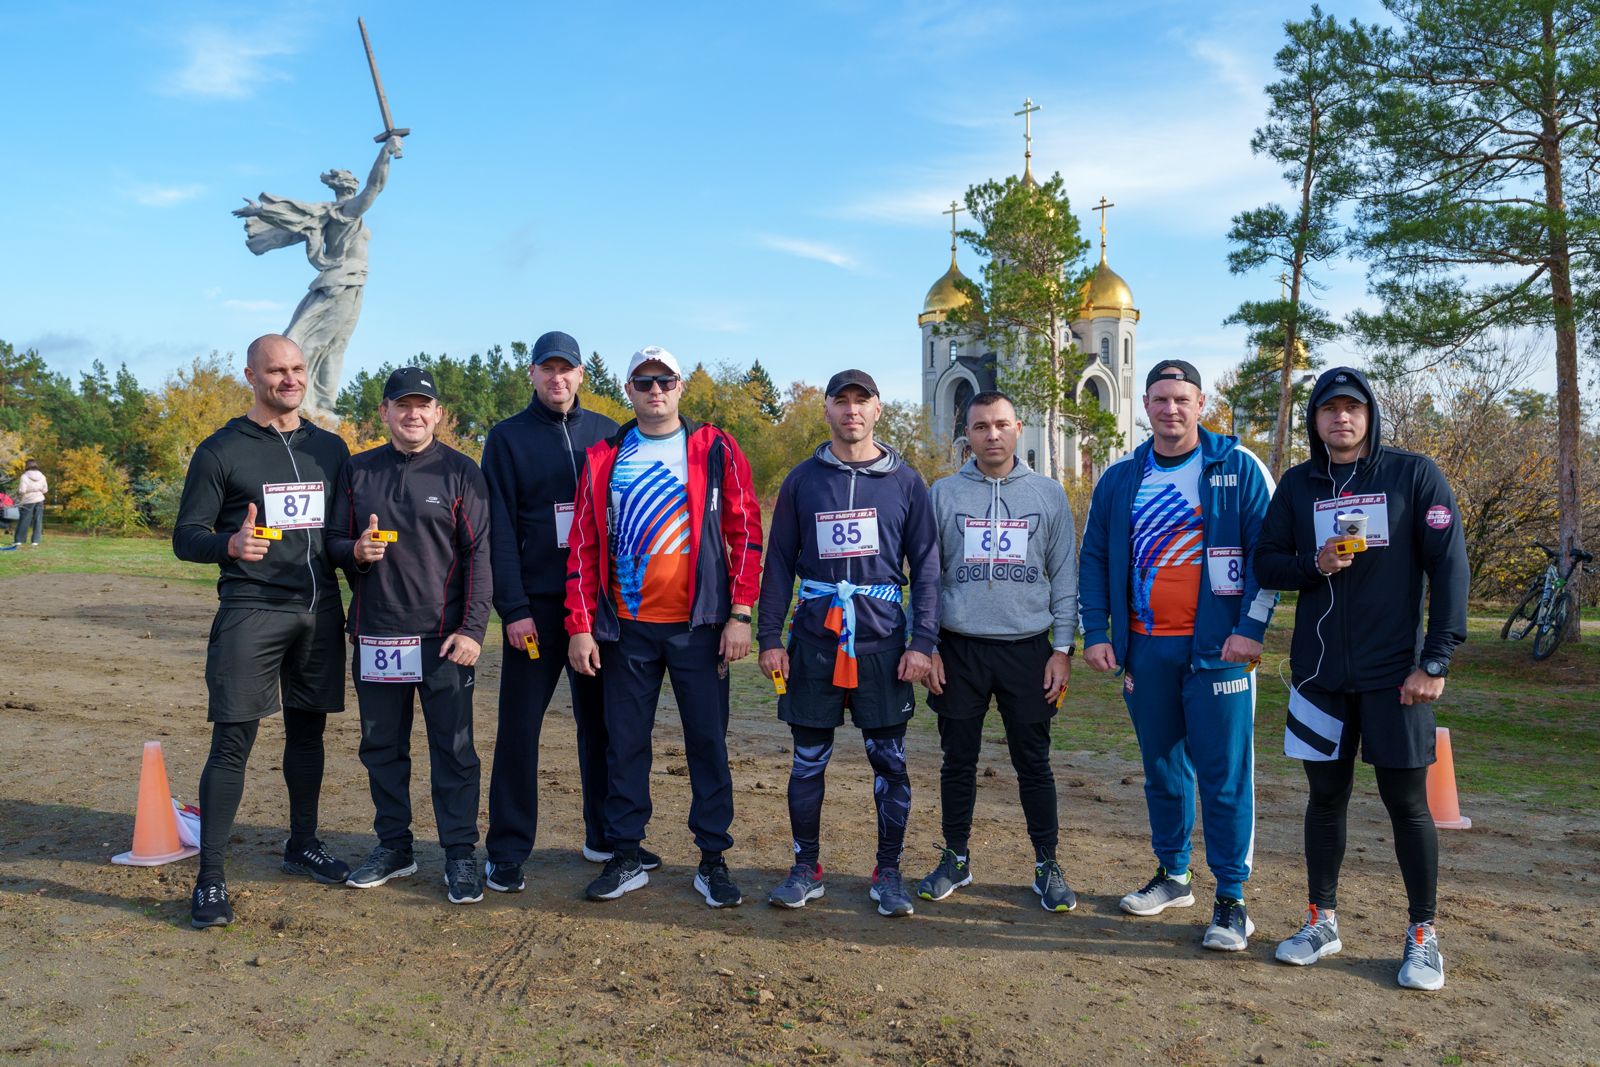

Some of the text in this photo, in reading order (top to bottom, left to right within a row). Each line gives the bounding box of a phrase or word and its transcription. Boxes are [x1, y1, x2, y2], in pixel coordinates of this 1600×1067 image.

[283, 494, 311, 517] 87
[832, 522, 862, 546] 85
[981, 530, 1012, 552] 86
[956, 564, 1039, 583] adidas
[374, 648, 402, 670] 81
[1213, 677, 1249, 695] PUMA
